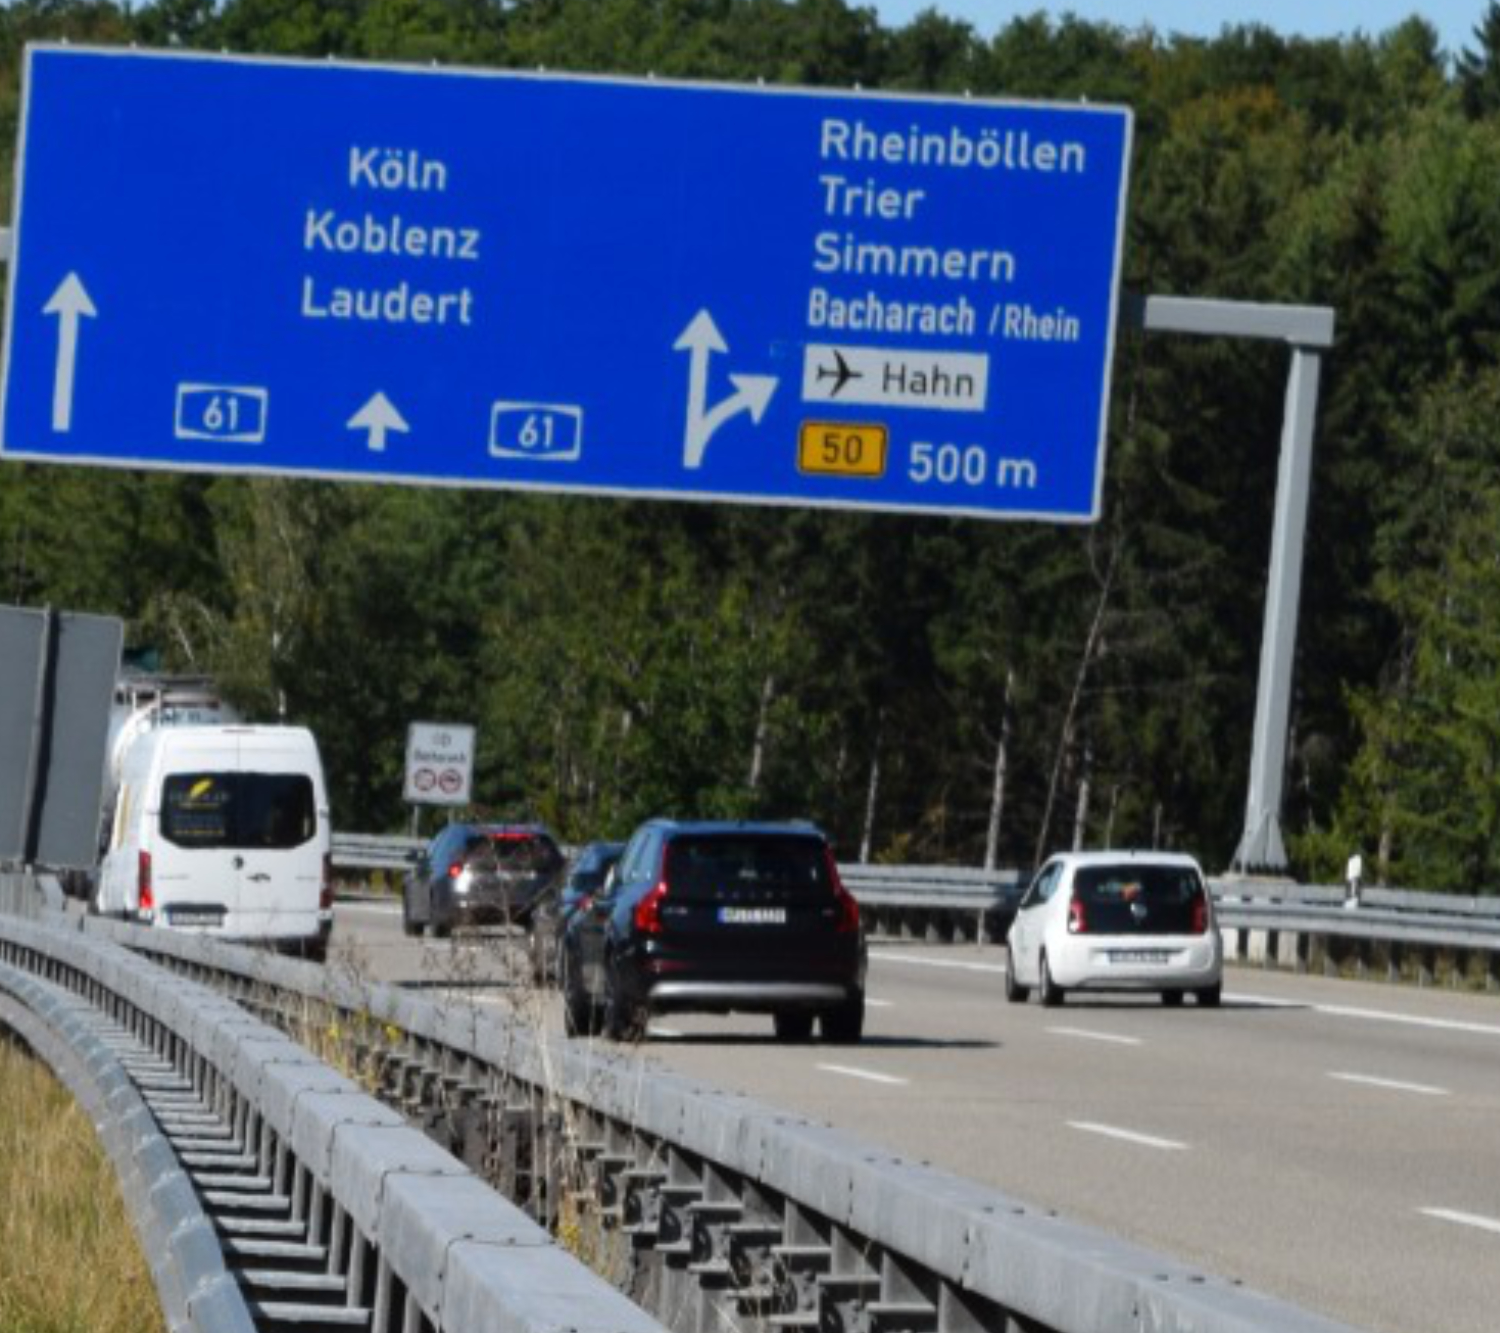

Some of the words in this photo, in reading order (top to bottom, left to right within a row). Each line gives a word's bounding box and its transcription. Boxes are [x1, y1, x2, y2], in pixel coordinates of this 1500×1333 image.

[349, 145, 447, 190] Köln
[819, 117, 1087, 173] Rheinböllen
[818, 174, 926, 219] Trier
[303, 208, 481, 260] Koblenz
[812, 231, 1016, 281] Simmern
[301, 275, 473, 326] Laudert
[806, 286, 976, 336] Bacharach
[882, 361, 975, 397] Hahn
[202, 395, 239, 431] 61
[518, 413, 554, 448] 61
[821, 433, 863, 465] 50
[908, 441, 986, 486] 500
[996, 457, 1037, 489] m
